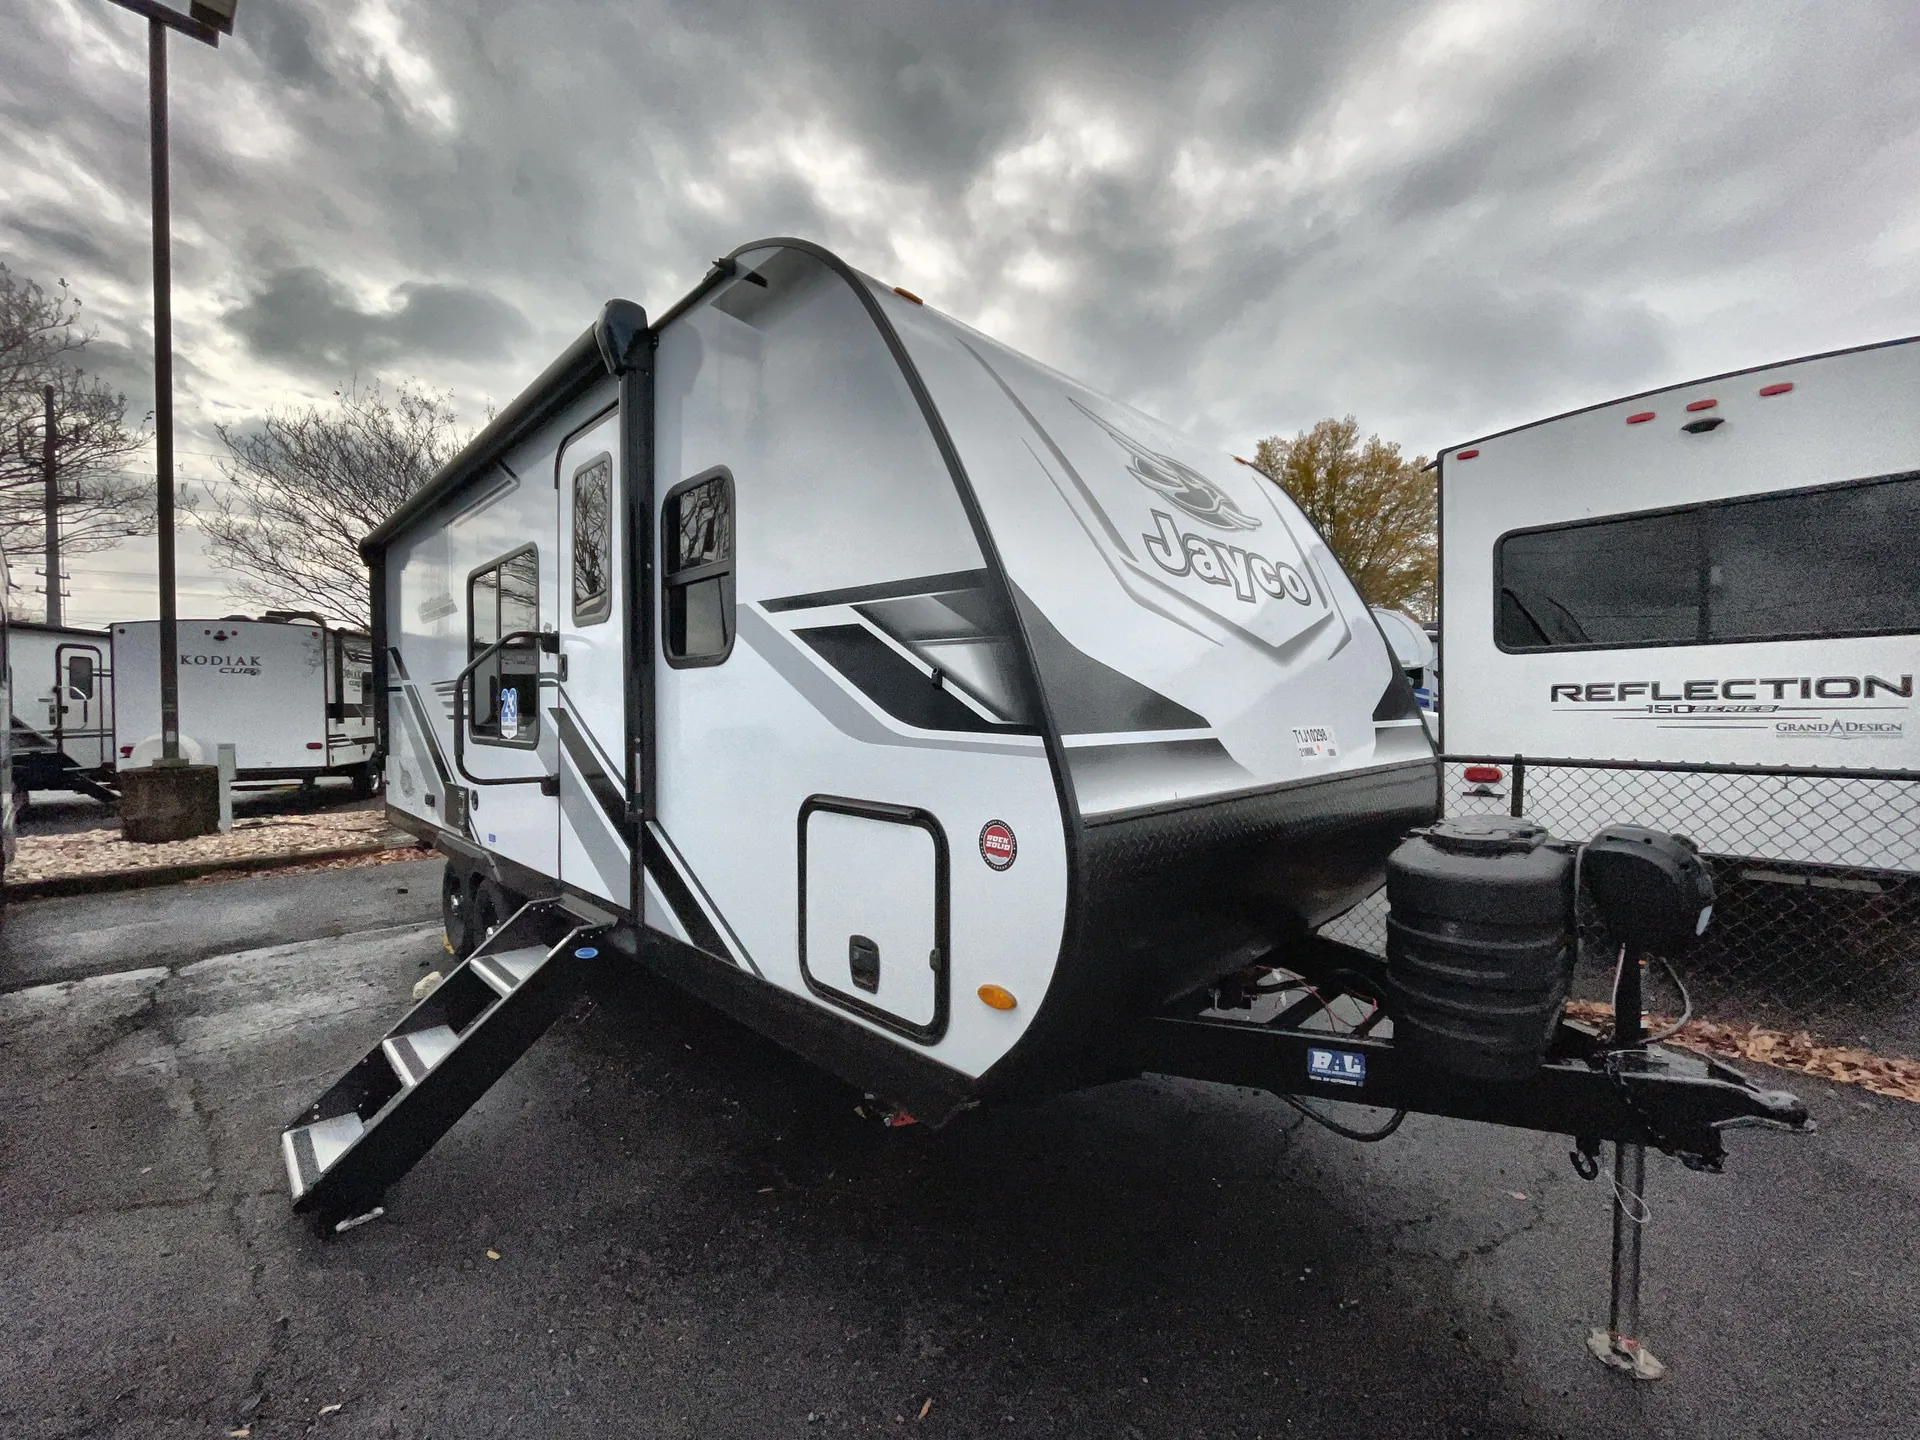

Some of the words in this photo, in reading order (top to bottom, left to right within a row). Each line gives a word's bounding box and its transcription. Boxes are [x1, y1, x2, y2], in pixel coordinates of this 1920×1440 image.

[1142, 508, 1312, 606] Jayco
[180, 654, 262, 666] KODIAK
[1550, 674, 1913, 702] REFLECTION
[501, 688, 518, 718] 23
[1646, 704, 1693, 714] 150
[1692, 704, 1779, 714] SERIES
[986, 834, 1009, 844] ROCK
[985, 841, 1011, 851] SOLID
